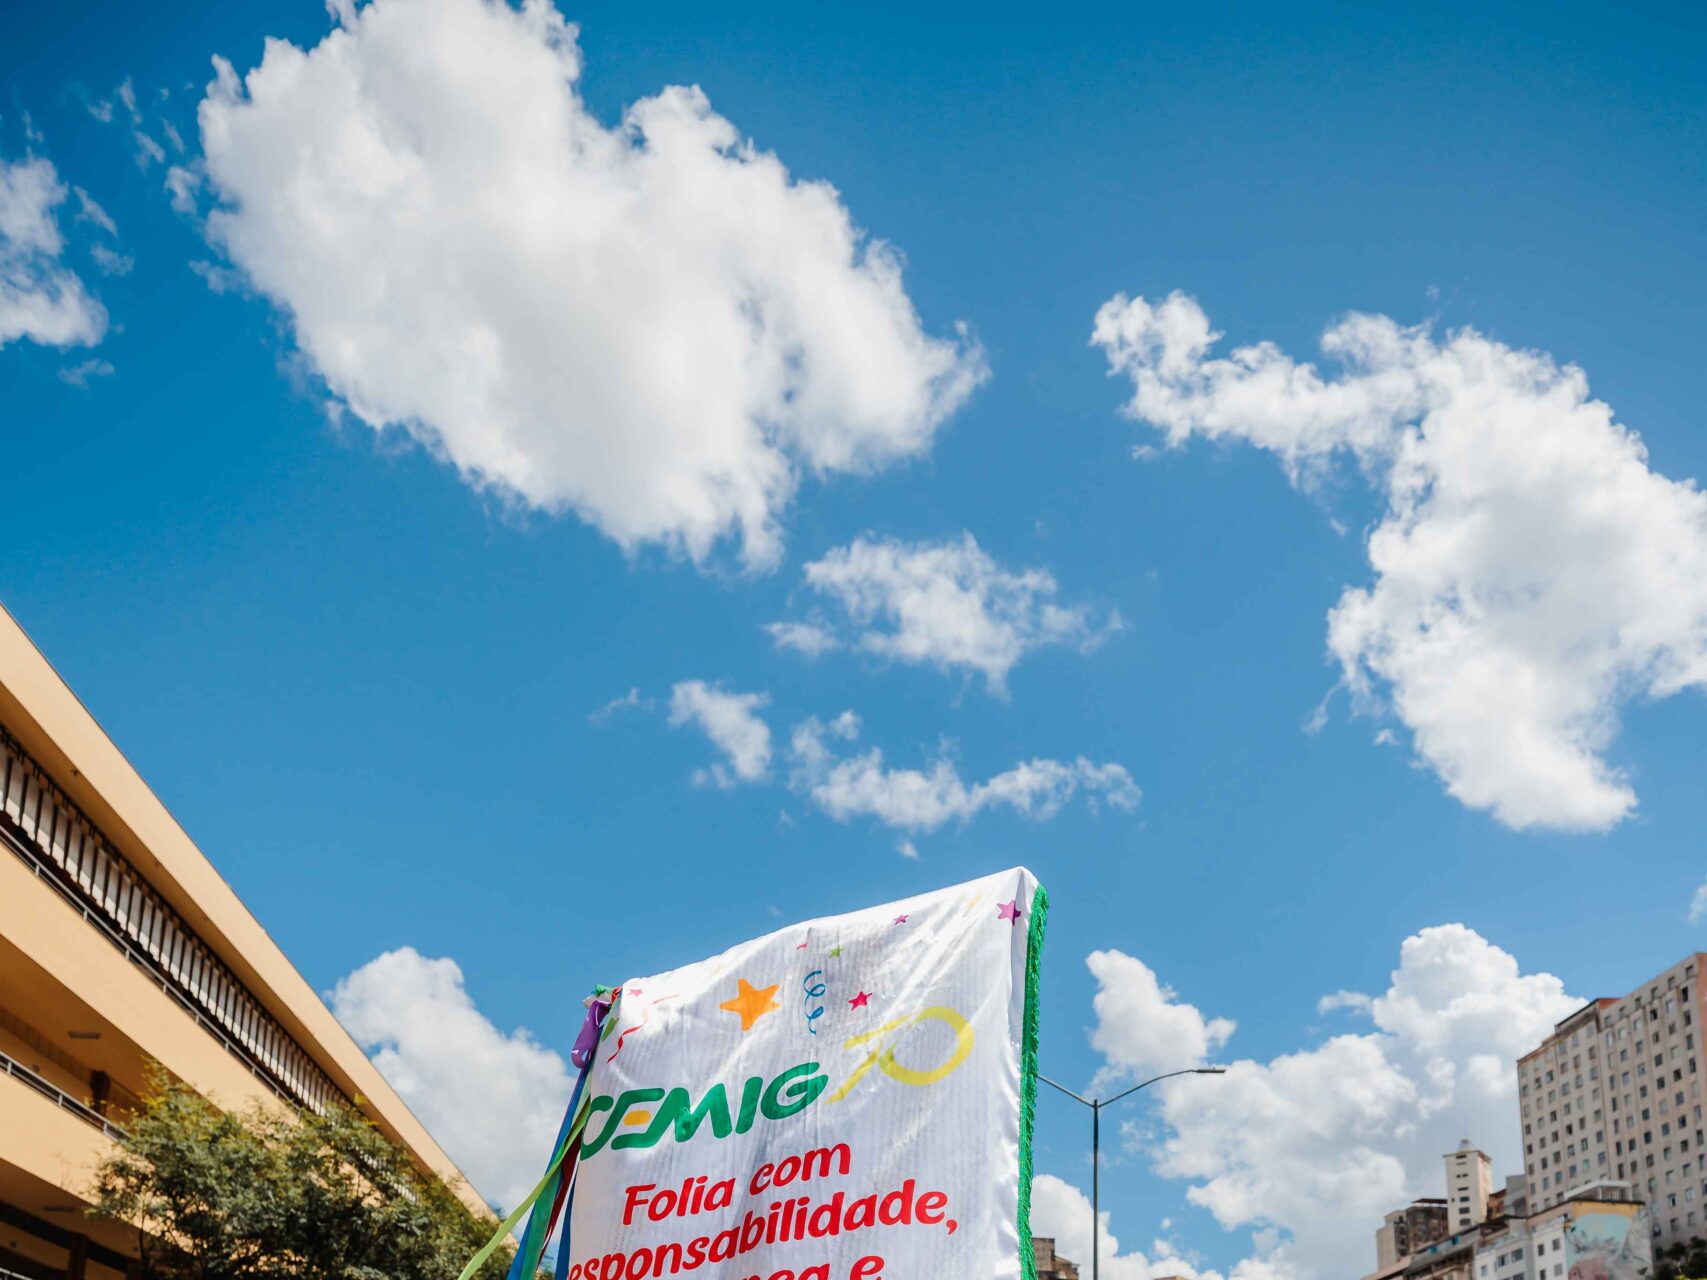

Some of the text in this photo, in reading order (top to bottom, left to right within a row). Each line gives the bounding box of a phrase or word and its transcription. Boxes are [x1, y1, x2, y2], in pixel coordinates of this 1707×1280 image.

[580, 1062, 829, 1160] CEMIG
[623, 1143, 851, 1226] Folia com
